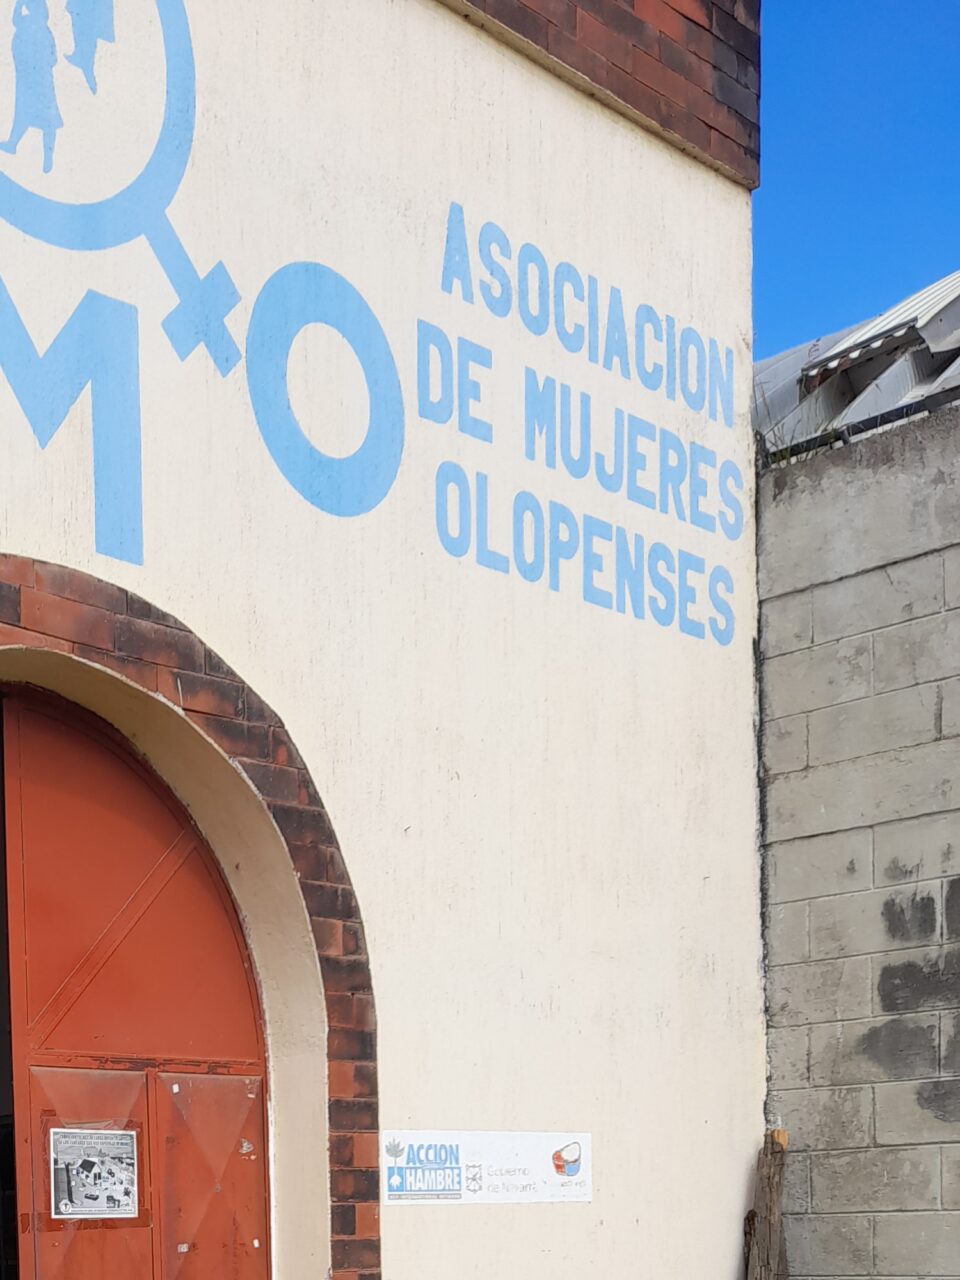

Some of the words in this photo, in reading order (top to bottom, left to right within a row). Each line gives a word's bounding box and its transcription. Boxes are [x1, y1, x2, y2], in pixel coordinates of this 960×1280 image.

[441, 201, 733, 428] ASOCIACION
[417, 318, 493, 443] DE
[525, 366, 743, 541] MUJERES
[435, 460, 735, 646] OLOPENSES
[406, 1143, 459, 1165] ACCION
[406, 1168, 460, 1190] HAMBRE
